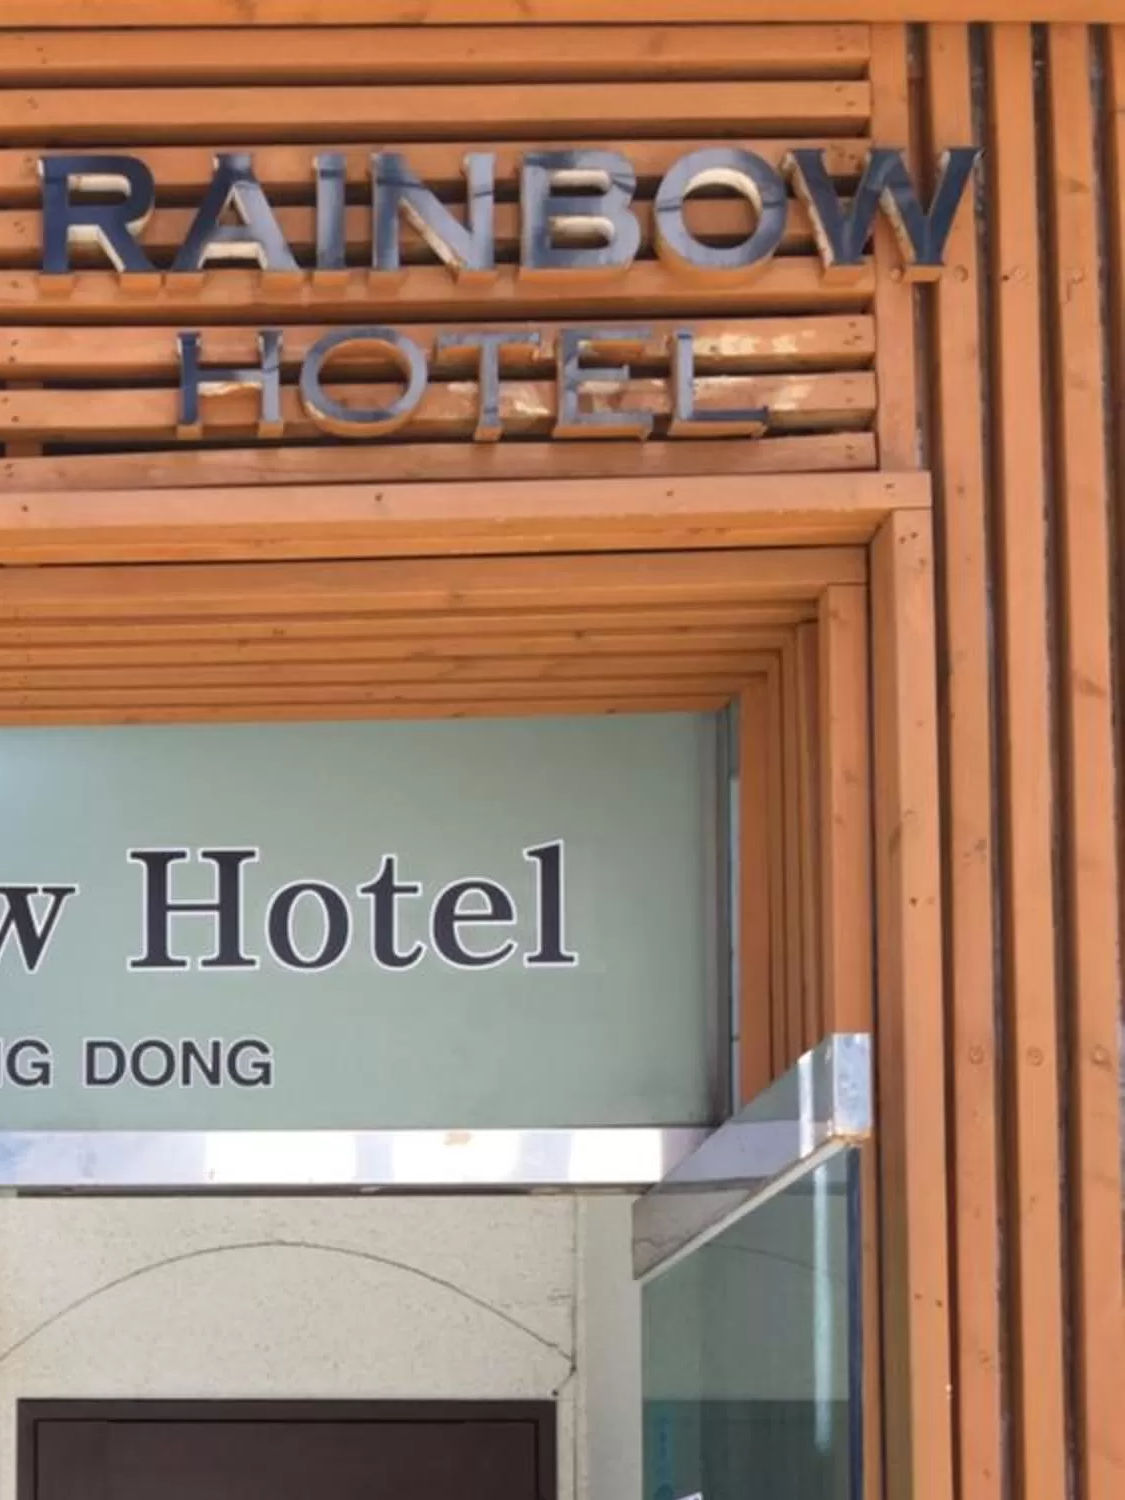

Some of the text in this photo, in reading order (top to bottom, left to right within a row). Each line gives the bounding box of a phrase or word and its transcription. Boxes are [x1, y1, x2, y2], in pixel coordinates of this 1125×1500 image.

[37, 146, 981, 280] RAINBOW
[176, 326, 771, 438] HOTEL
[126, 838, 579, 972] Hotel
[83, 1037, 274, 1088] DONG
